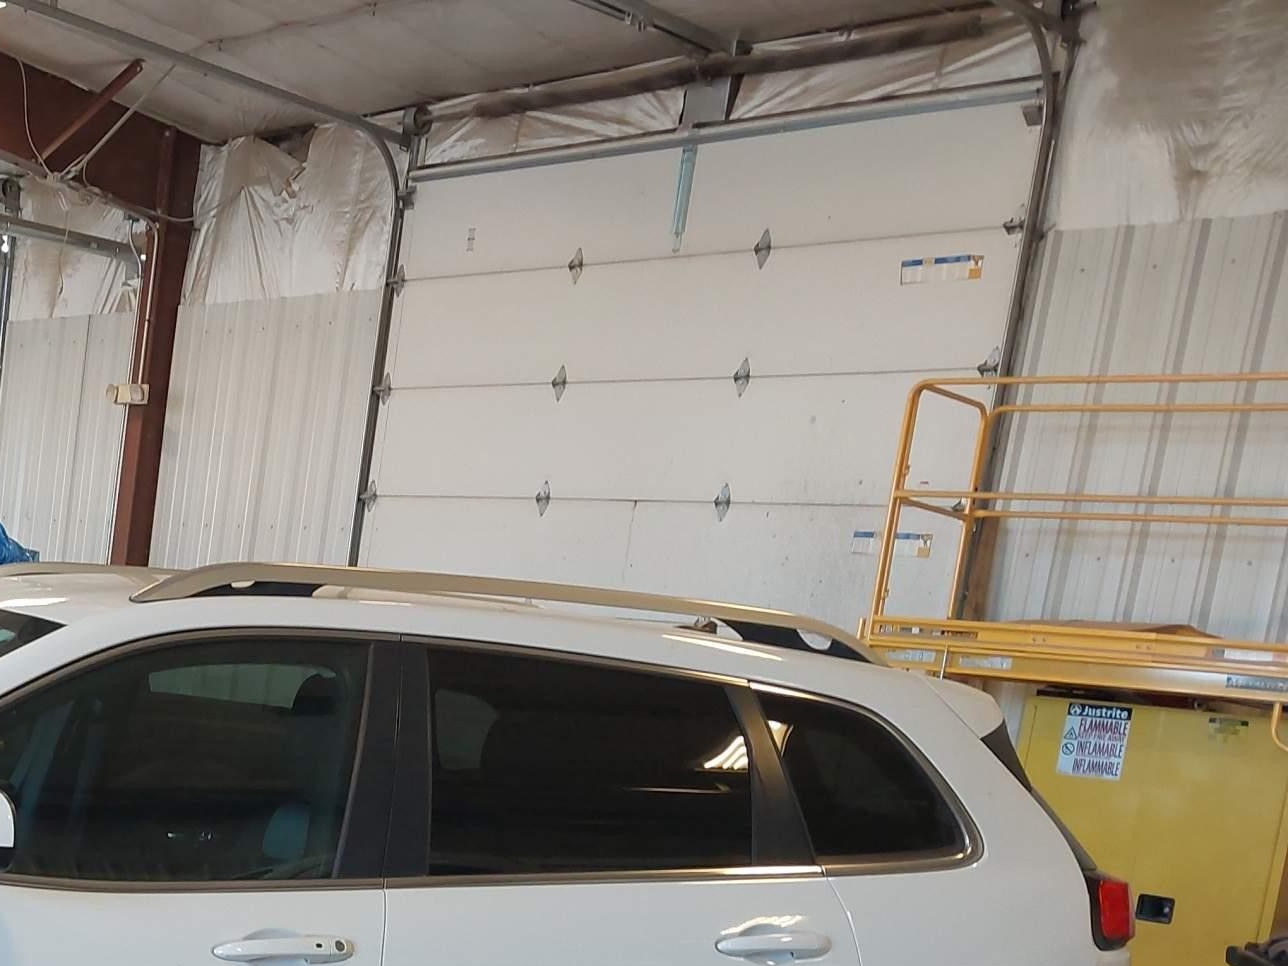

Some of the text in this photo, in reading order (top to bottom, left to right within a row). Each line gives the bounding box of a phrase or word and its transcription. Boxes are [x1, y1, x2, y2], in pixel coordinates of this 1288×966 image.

[1083, 705, 1129, 719] Justrite
[1079, 718, 1128, 736] FLAMMABLE
[1075, 740, 1123, 758] INFLAMABLE
[1072, 759, 1120, 777] INFLAMMABLE
